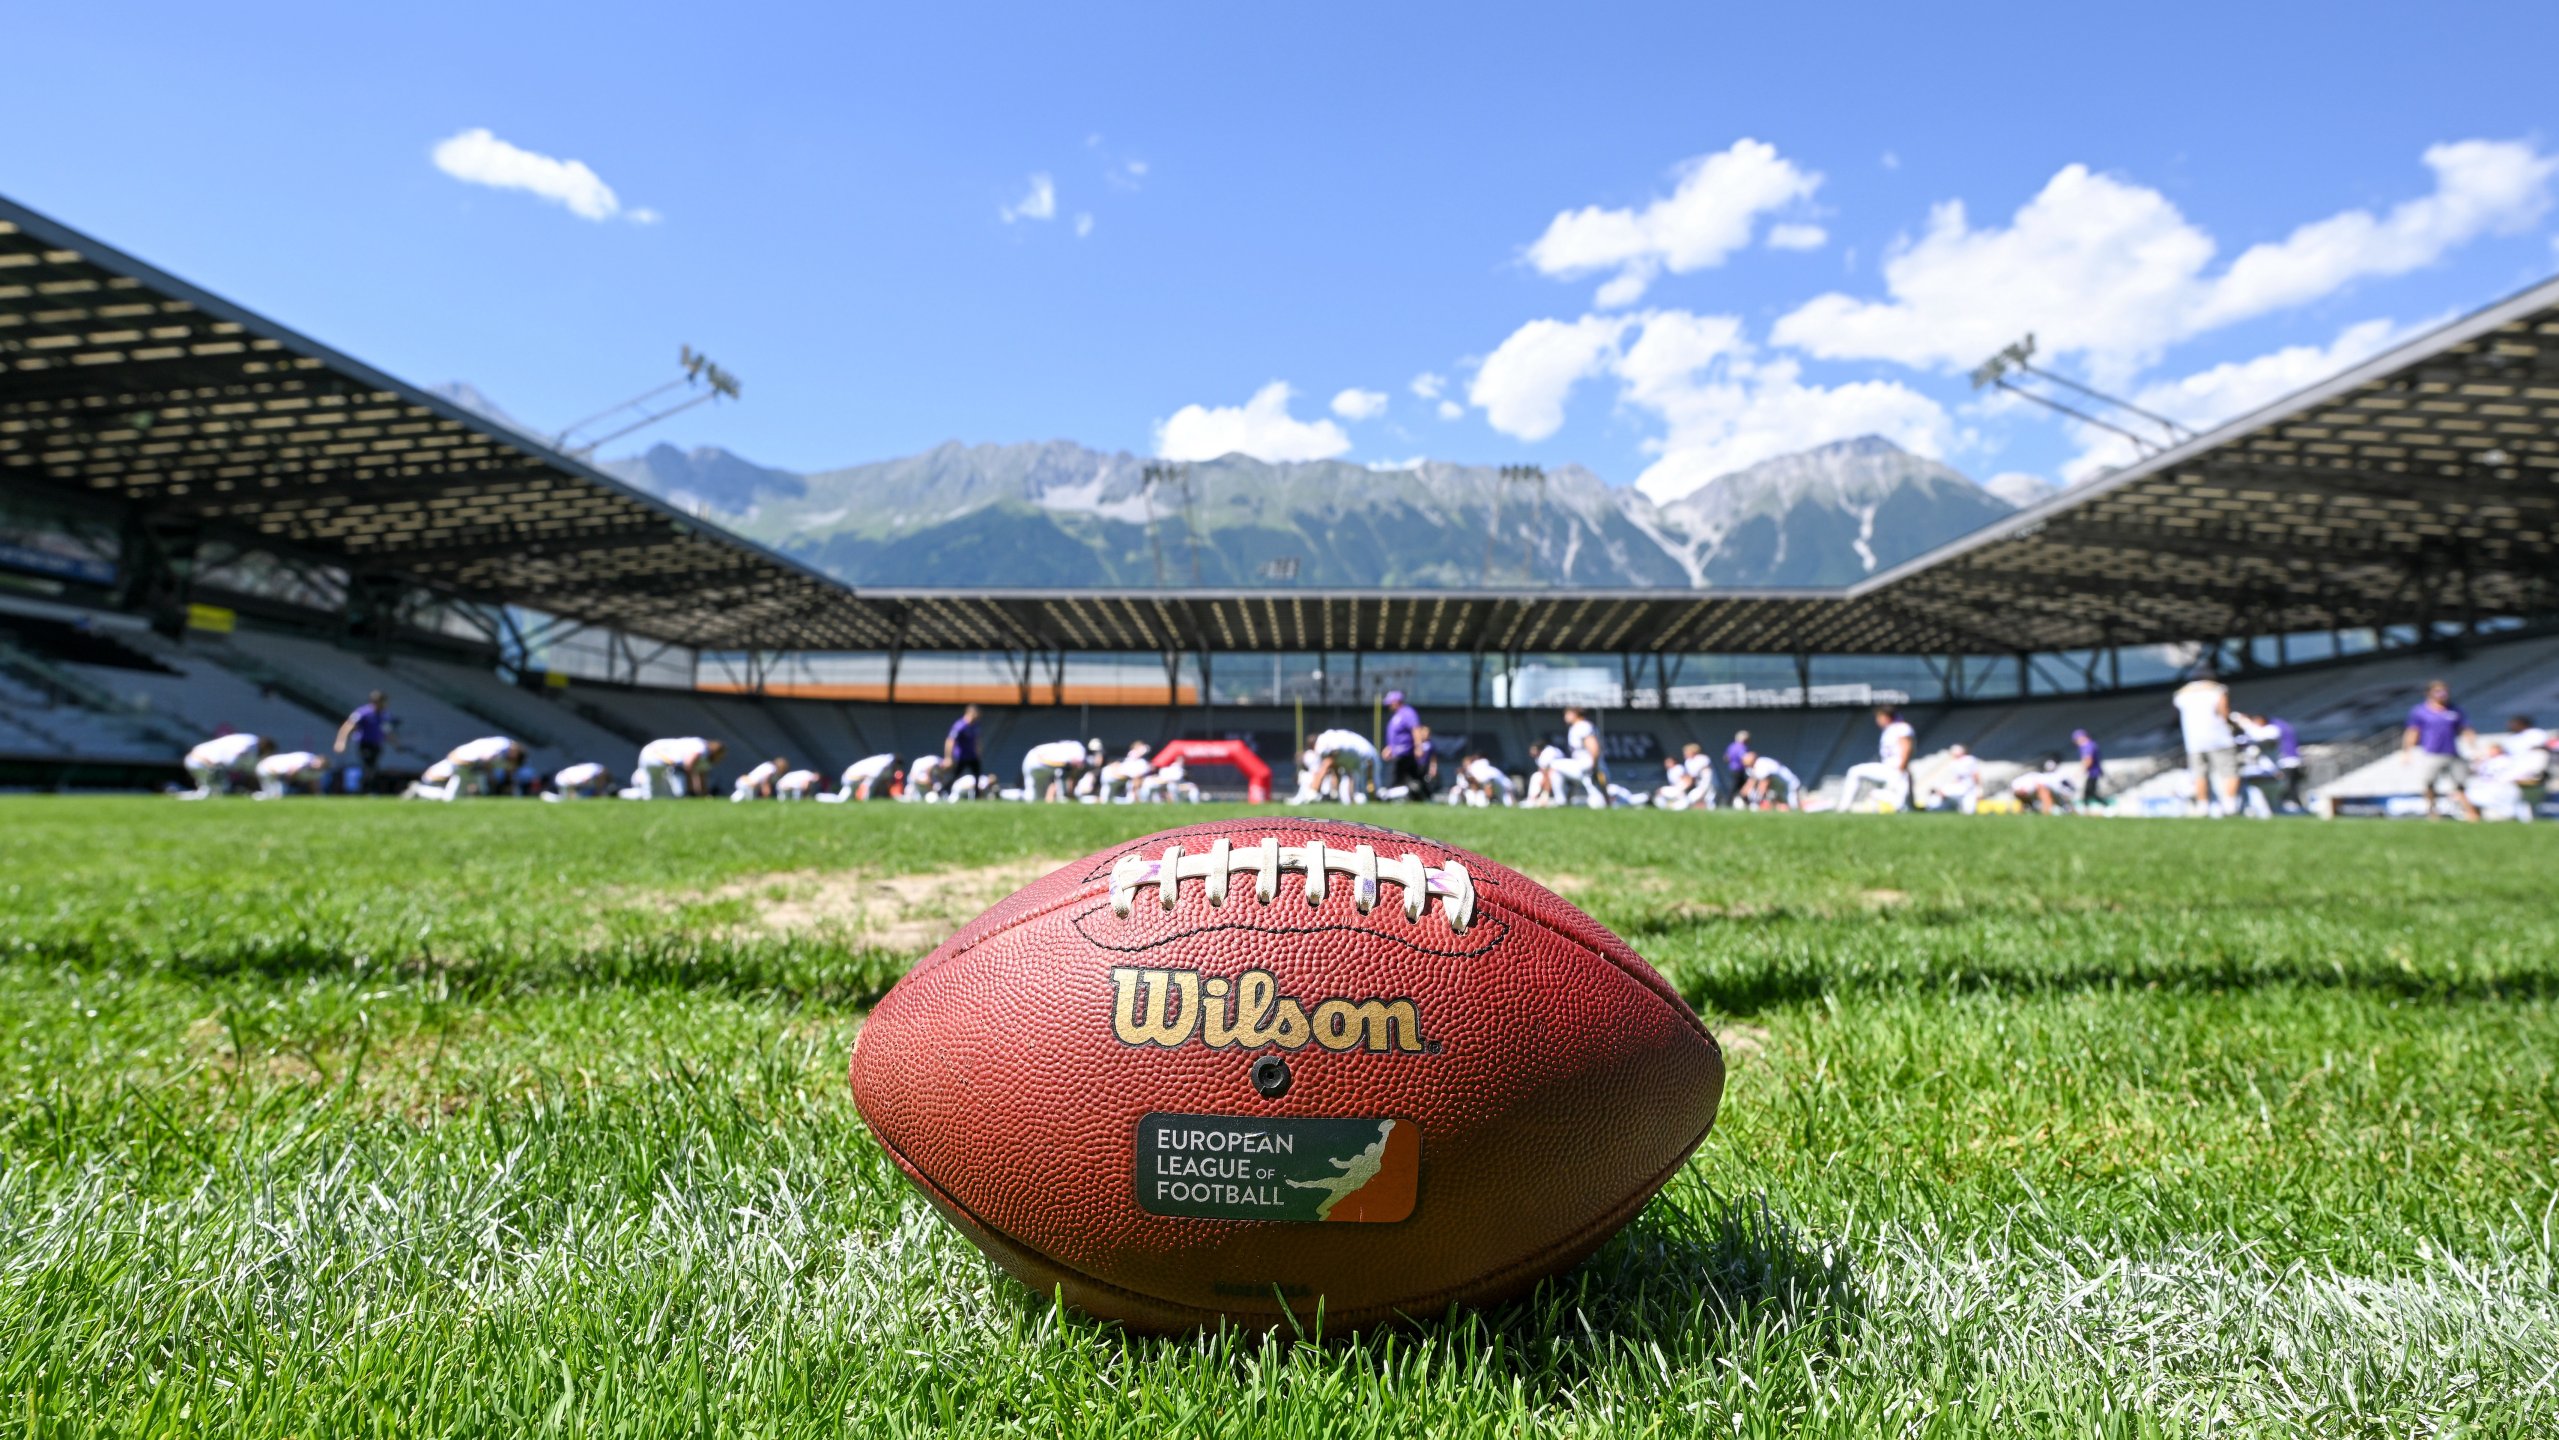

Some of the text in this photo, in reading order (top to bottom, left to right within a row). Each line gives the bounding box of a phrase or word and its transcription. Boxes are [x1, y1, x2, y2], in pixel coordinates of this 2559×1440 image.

[1111, 965, 1426, 1053] Wilson
[1157, 1128, 1294, 1155] EUROPEAN
[1157, 1154, 1276, 1180] LEAGUE OF
[1157, 1180, 1285, 1206] FOOTBALL
